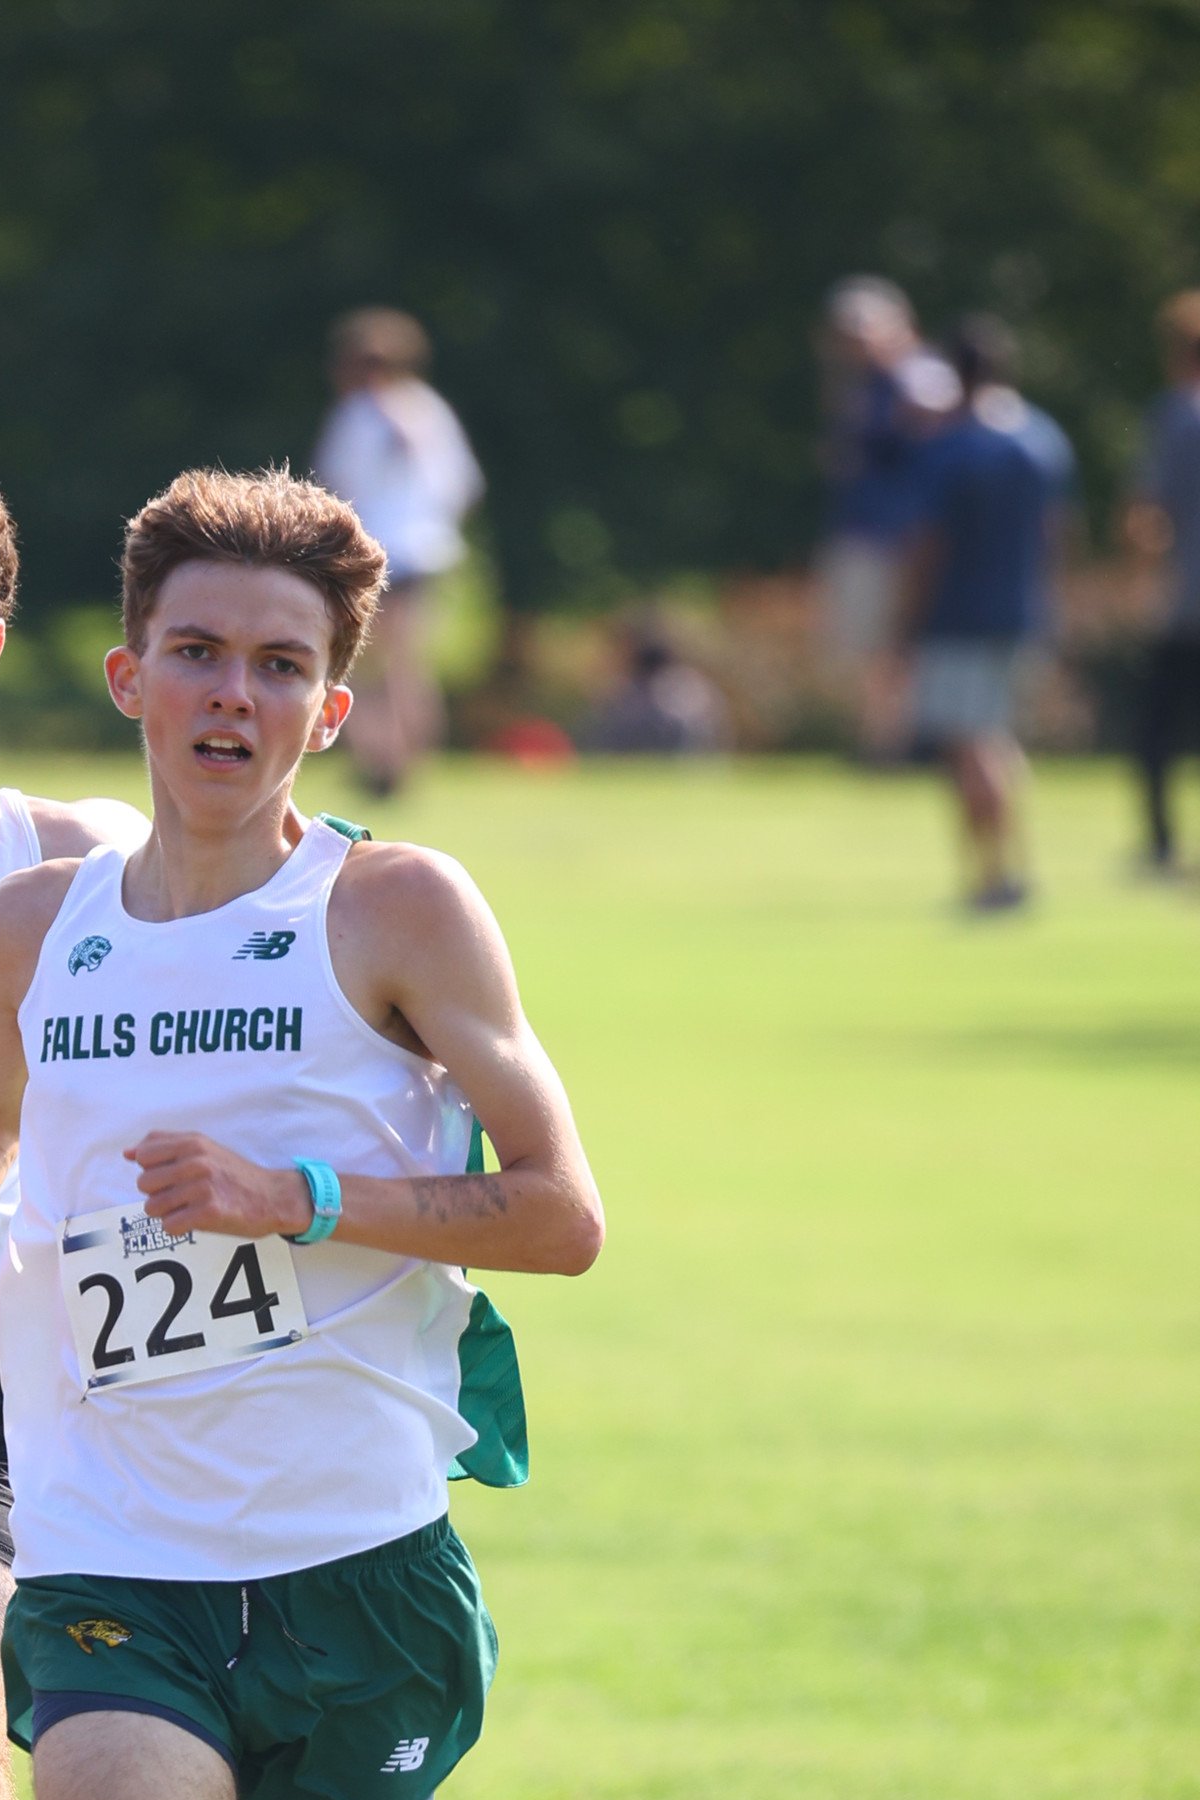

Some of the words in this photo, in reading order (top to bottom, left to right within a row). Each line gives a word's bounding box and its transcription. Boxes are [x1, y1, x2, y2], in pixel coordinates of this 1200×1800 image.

[40, 1013, 136, 1063] FALLS
[149, 1006, 303, 1056] CHURCH
[79, 1242, 280, 1370] 224
